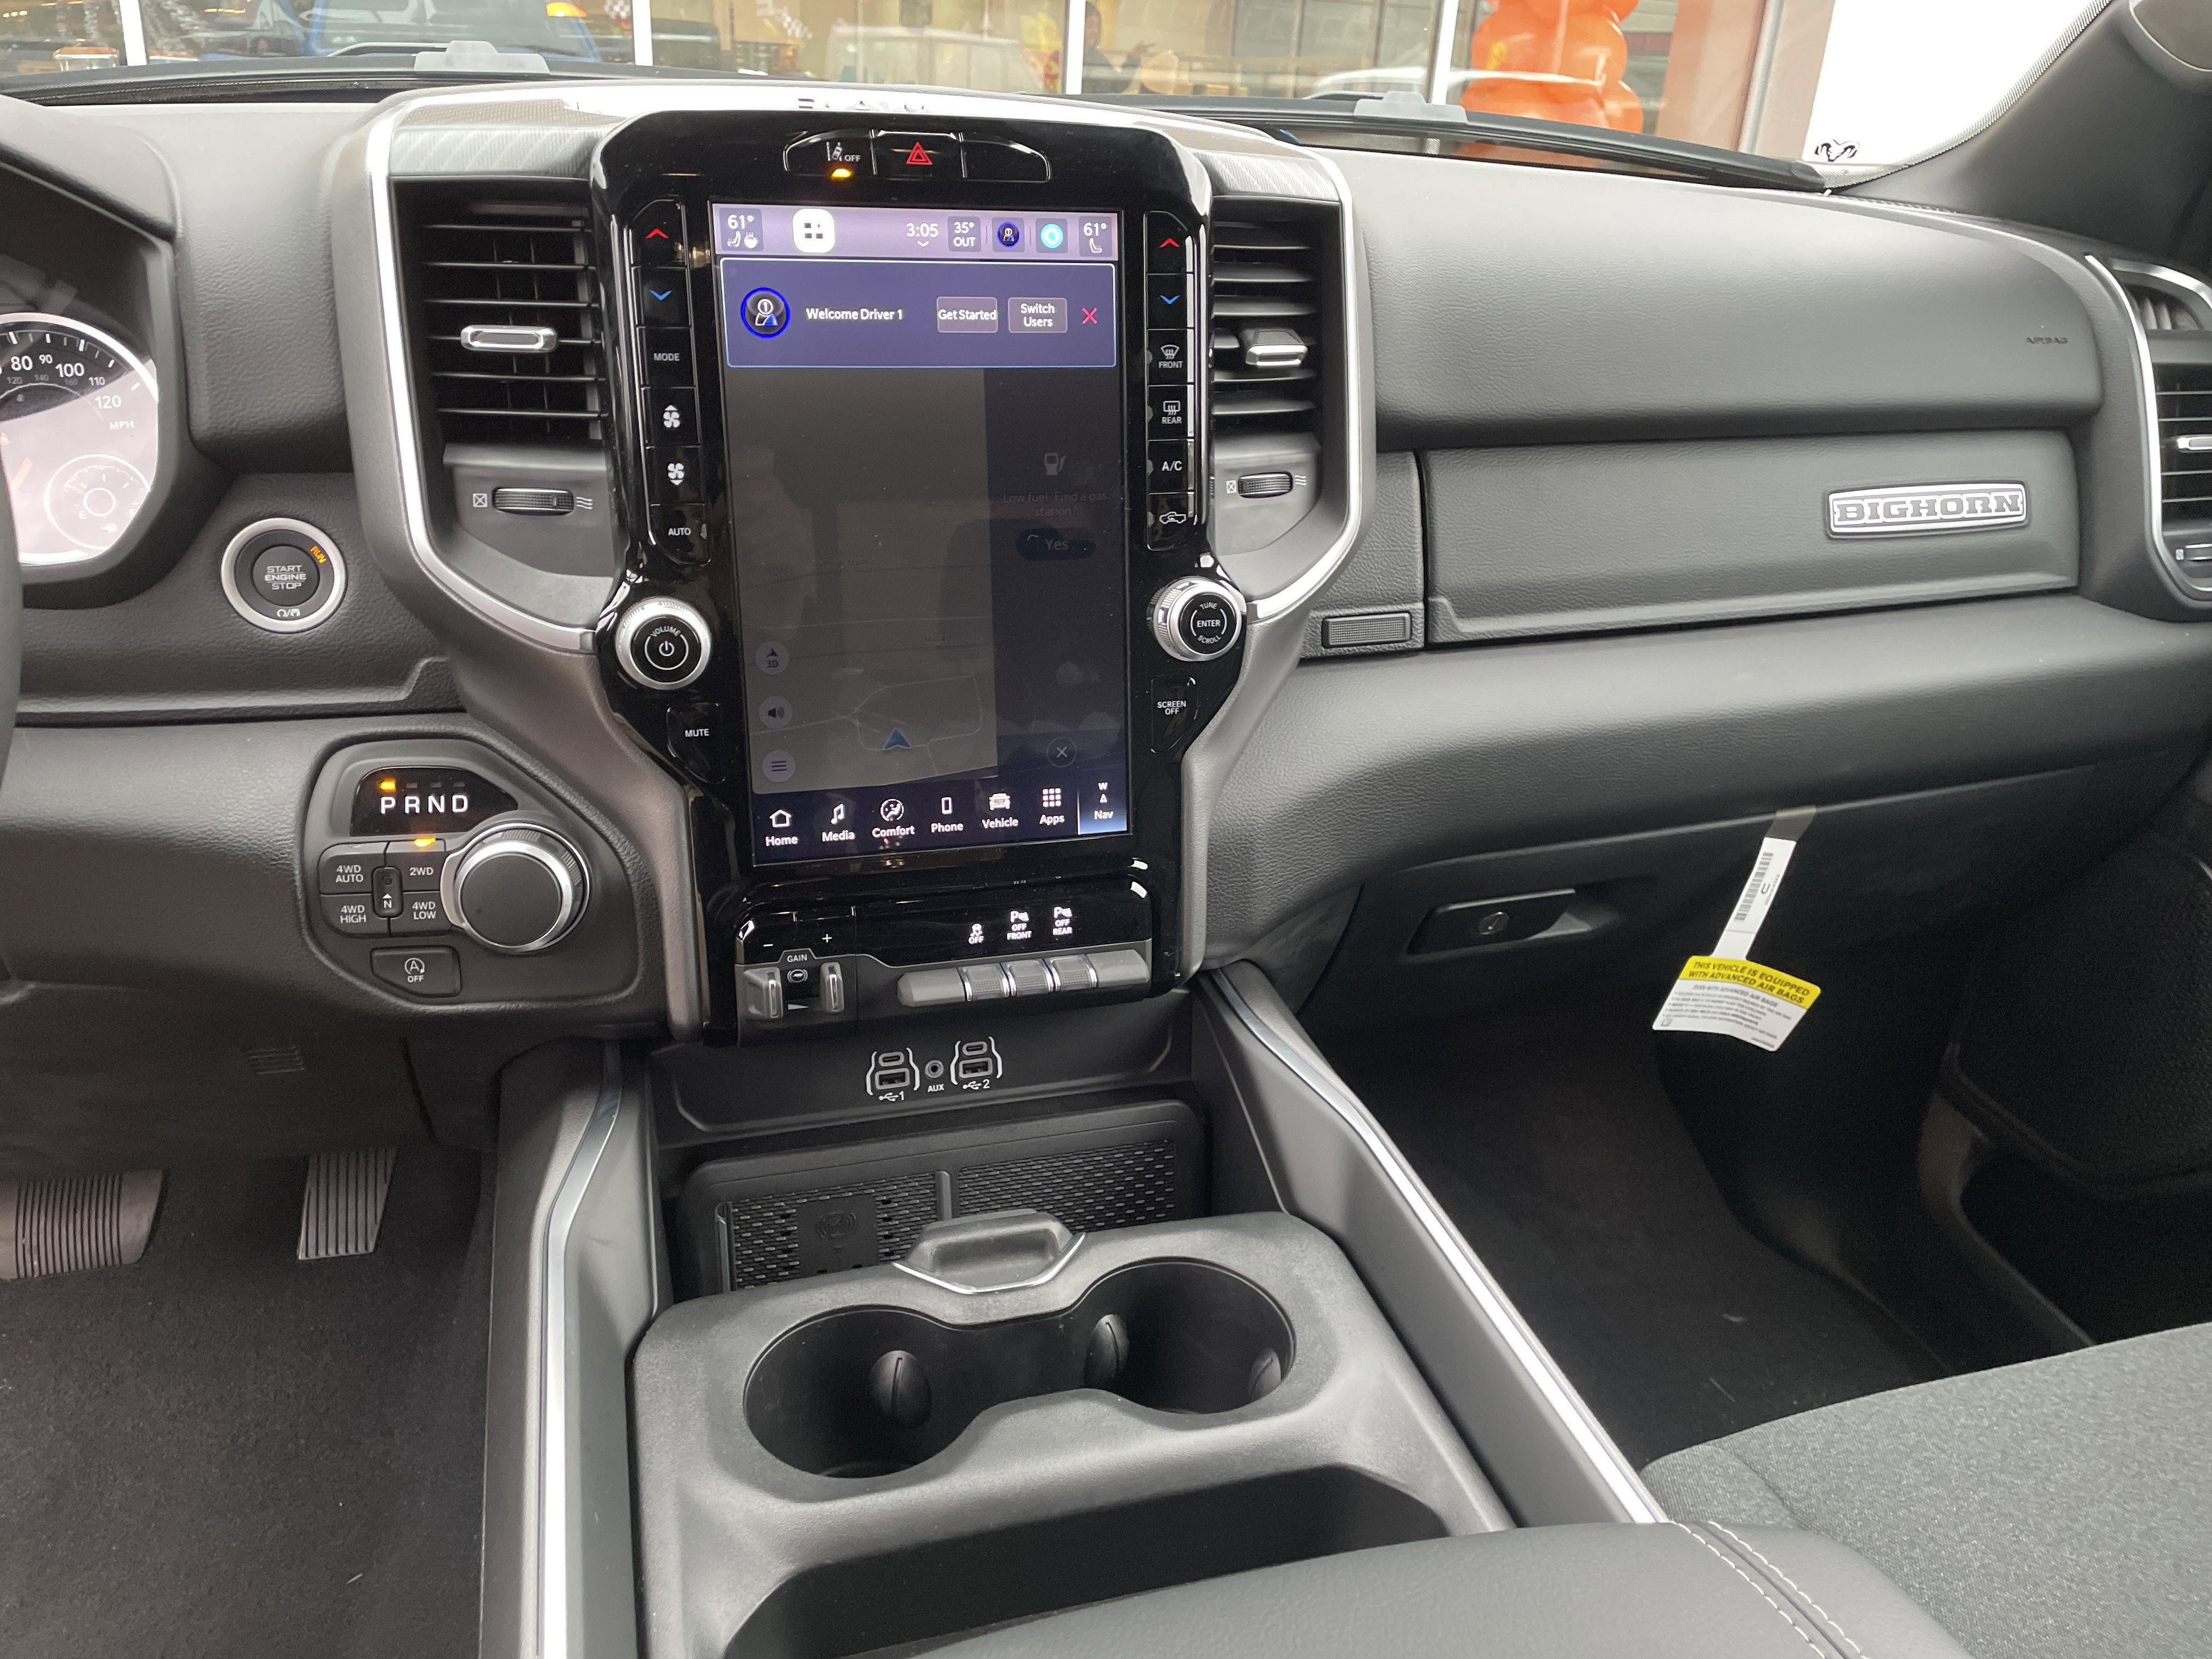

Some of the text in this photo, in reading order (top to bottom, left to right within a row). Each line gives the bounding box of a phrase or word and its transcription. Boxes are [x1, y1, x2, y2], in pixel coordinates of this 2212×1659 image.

[728, 215, 754, 229] 61°
[906, 223, 939, 237] 3:05
[953, 222, 974, 234] 35°
[1084, 222, 1107, 236] 61°
[953, 236, 976, 247] OUT
[1020, 303, 1055, 314] Switch
[806, 308, 902, 320] Welcome Driver 1
[938, 309, 997, 320] Get Started
[1023, 316, 1053, 327] Users
[39, 354, 53, 364] 90
[653, 353, 680, 362] MODE
[10, 356, 33, 371] 80
[55, 363, 84, 377] 100
[7, 376, 23, 385] 120
[89, 376, 105, 386] 110
[95, 394, 121, 409] 120
[109, 420, 134, 430] MPH
[1162, 461, 1182, 471] A/C
[1003, 493, 1025, 503] Low
[1054, 492, 1077, 502] Find
[1088, 493, 1107, 503] gas
[1034, 506, 1077, 517] station?
[1836, 492, 2022, 524] BIGHORN
[668, 528, 691, 536] AUTO
[1045, 538, 1068, 550] Yes
[310, 546, 327, 564] RUN
[264, 573, 307, 582] ENGINE
[1197, 619, 1221, 628] ENTER
[650, 625, 681, 637] VOLUME
[1198, 635, 1222, 644] SCROLL
[1157, 700, 1187, 709] SCREEN
[685, 729, 709, 737] MUTE
[1098, 782, 1108, 791] W
[1040, 814, 1065, 826] Apps
[1094, 810, 1113, 820] Nav
[931, 822, 964, 833] Phone
[982, 817, 1019, 829] Vehicle
[822, 830, 855, 842] Media
[871, 825, 915, 838] Comfort
[765, 835, 798, 847] Home
[336, 865, 362, 873] 4WD
[410, 867, 433, 876] 2WD
[336, 874, 364, 883] AUTO
[383, 899, 392, 909] N
[412, 901, 436, 910] 4WD
[341, 905, 365, 914] 4WD
[340, 914, 366, 923] HIGH
[413, 911, 437, 920] LOW
[1011, 923, 1027, 932] OFF
[1054, 919, 1070, 927] OFF
[1007, 931, 1032, 940] FRONT
[1052, 927, 1073, 935] REAR
[968, 935, 984, 944] OFF
[787, 954, 808, 963] GAIN
[407, 975, 424, 983] OFF
[1712, 963, 1747, 973] VEHICLE
[1747, 968, 1758, 977] IS
[1759, 972, 1810, 996] EQUIPPED
[1709, 971, 1756, 985] ADVANCED
[1758, 982, 1776, 992] AIR
[1776, 989, 1805, 1004] BAGS
[927, 1084, 945, 1092] AUX
[983, 1079, 990, 1090] 2
[899, 1091, 905, 1101] 1
